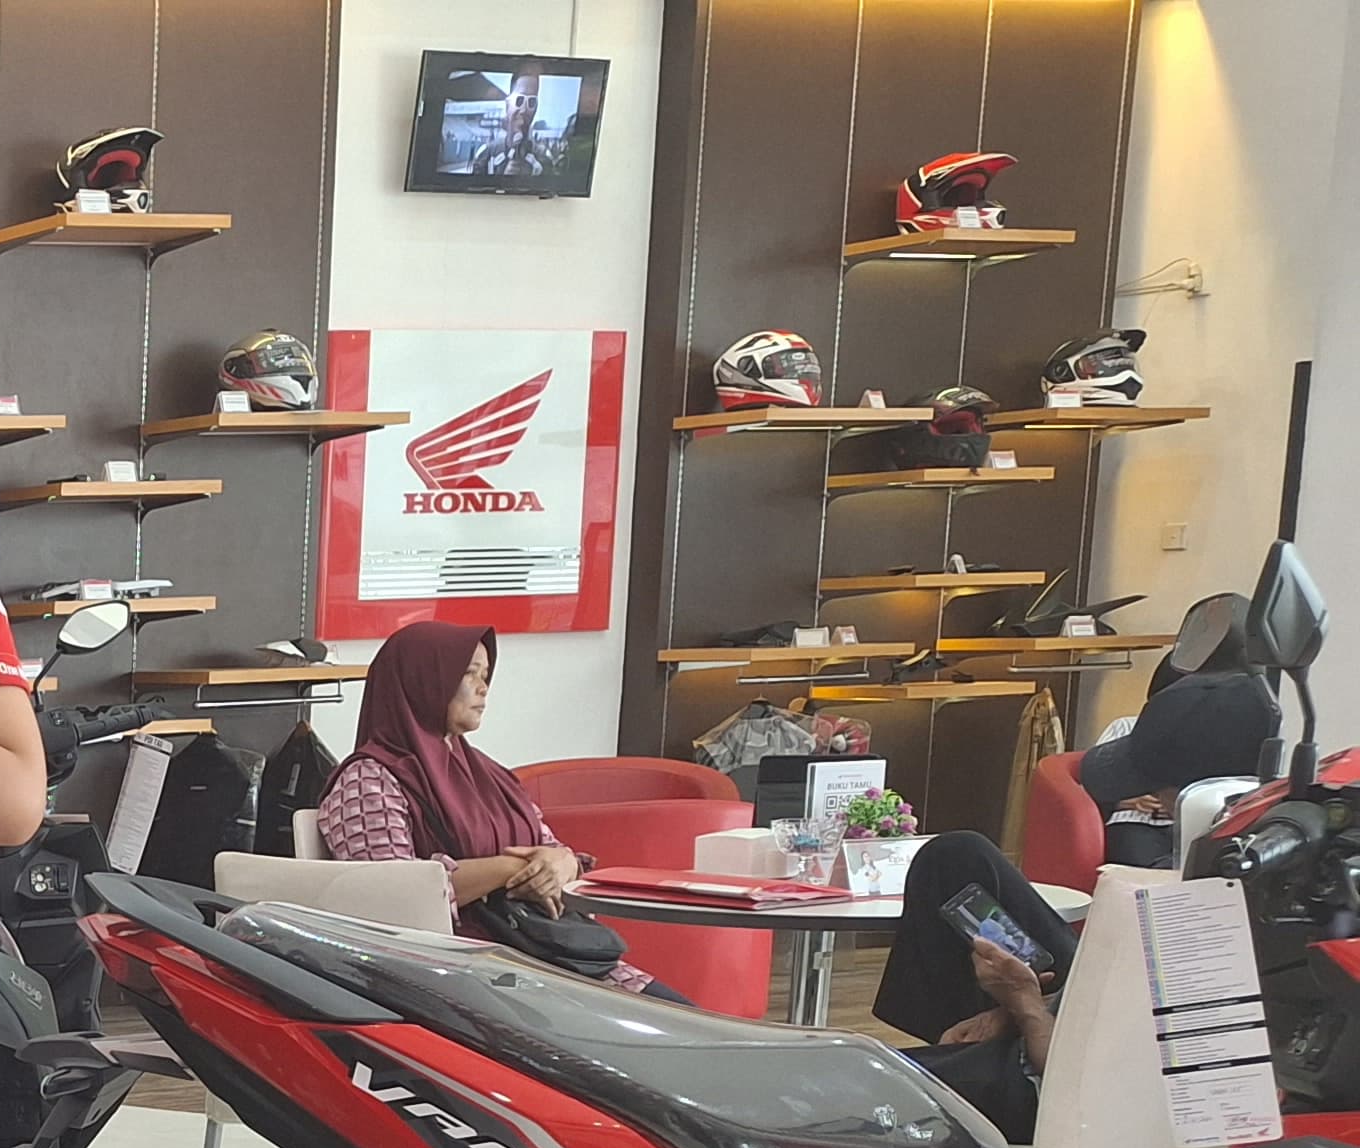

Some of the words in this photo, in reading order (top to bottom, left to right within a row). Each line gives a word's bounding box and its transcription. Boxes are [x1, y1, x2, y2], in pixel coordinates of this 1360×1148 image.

[402, 491, 545, 514] HONDA
[827, 781, 848, 791] BUKU
[850, 781, 872, 789] TAMU
